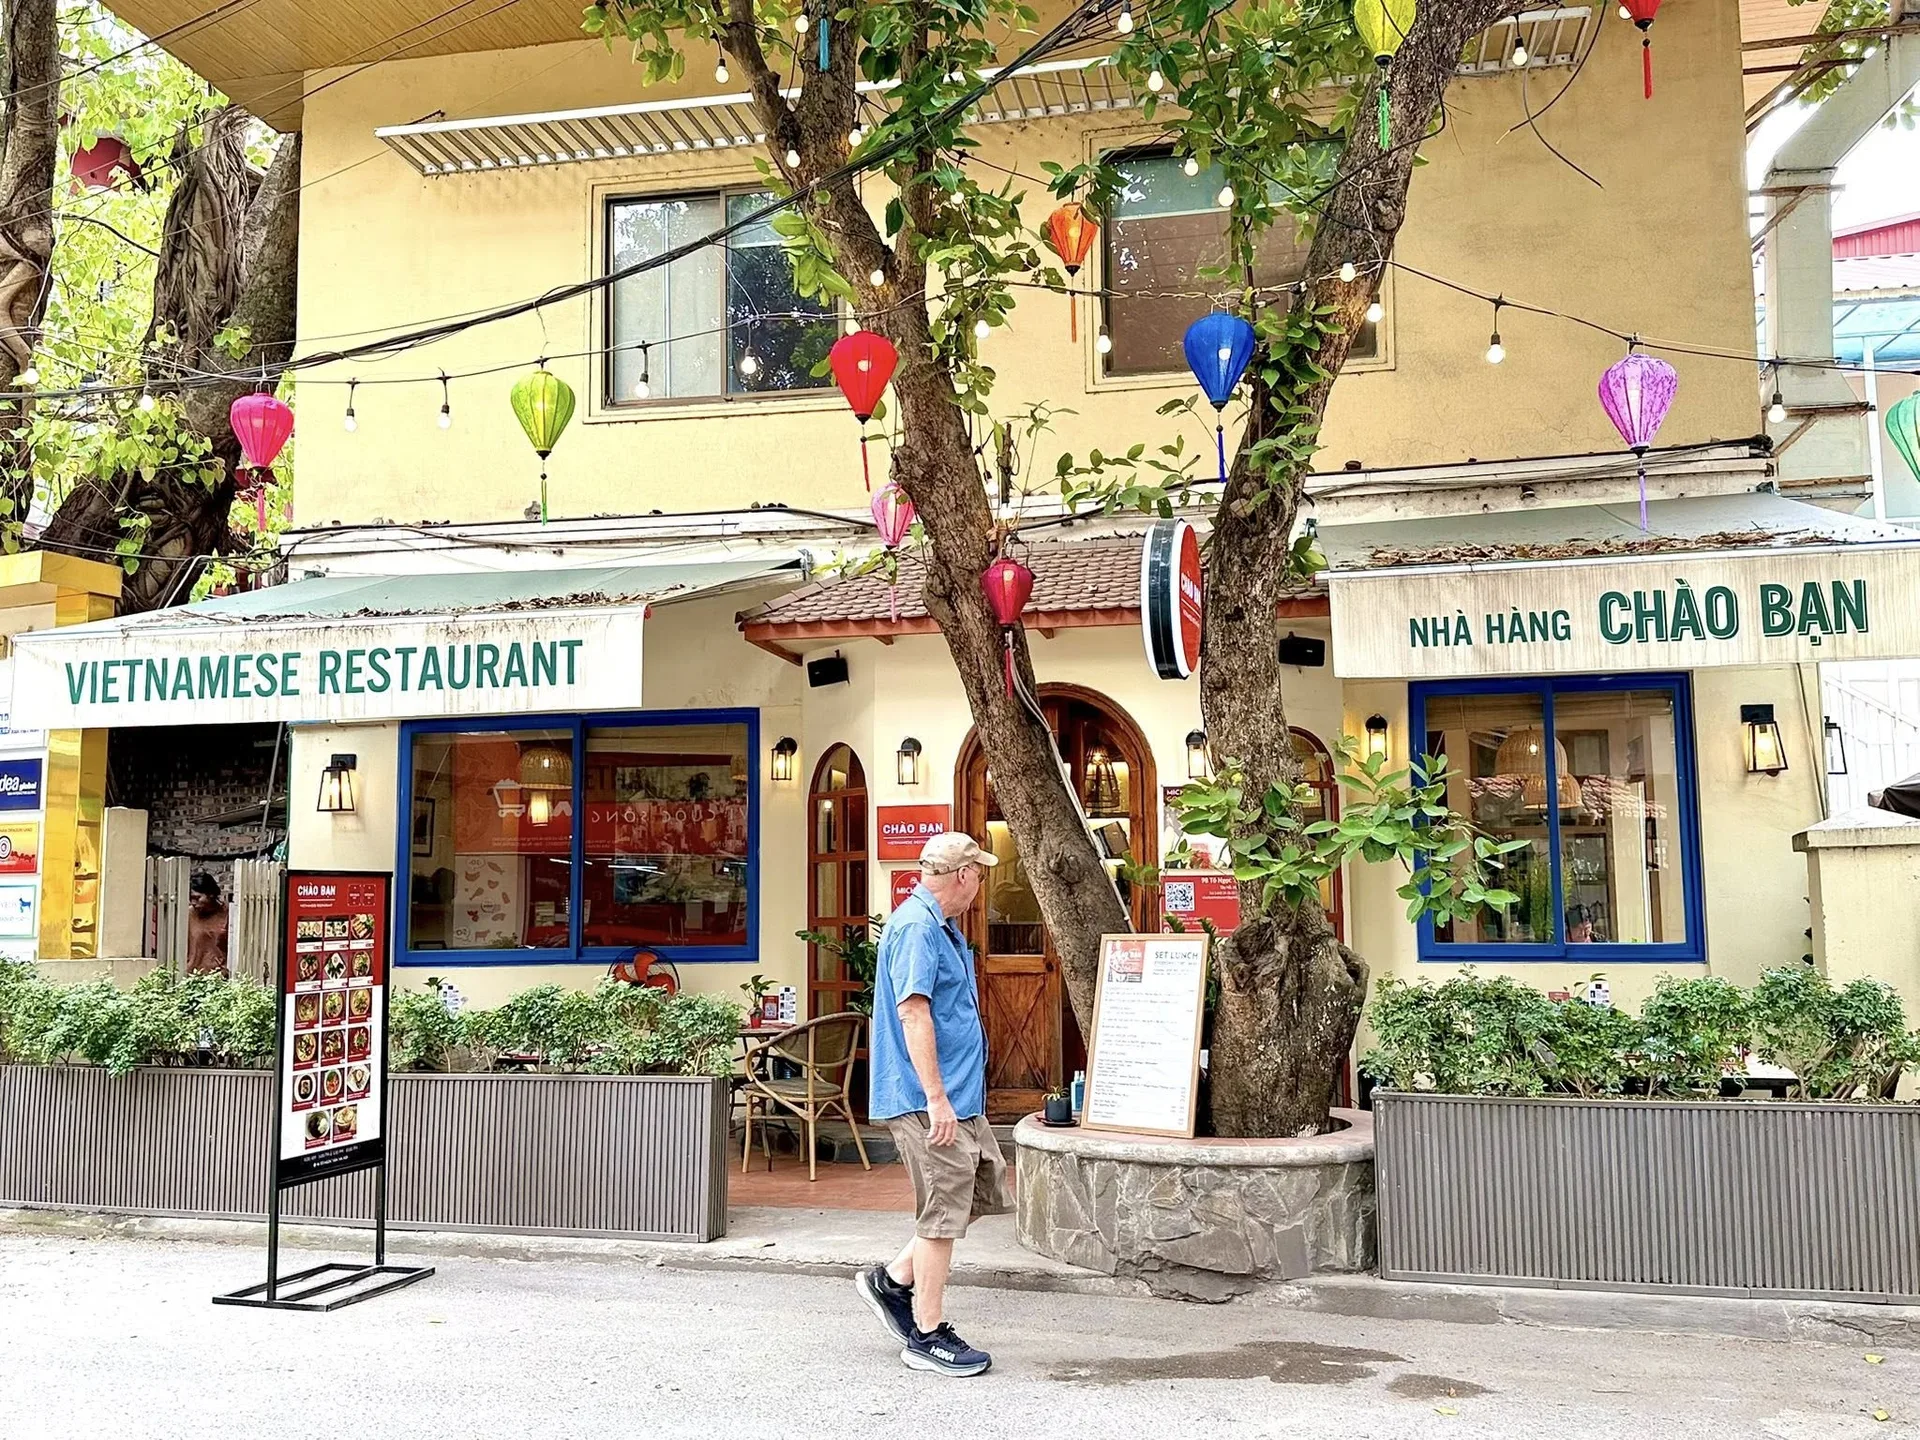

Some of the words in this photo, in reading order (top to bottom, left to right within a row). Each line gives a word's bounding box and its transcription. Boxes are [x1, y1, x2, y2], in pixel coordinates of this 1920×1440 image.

[1409, 609, 1473, 647] NHÀ
[1486, 606, 1572, 642] HÀNG
[1598, 577, 1739, 644] CHÀO
[1759, 579, 1869, 646] BẠN
[65, 652, 301, 704] VIETNAMESE
[318, 639, 583, 694] RESTAURANT
[882, 820, 915, 834] CHÀO
[919, 822, 944, 835] BẠN
[297, 882, 319, 896] CHÀO
[320, 886, 336, 898] BẠN
[1155, 951, 1169, 959] SET
[1170, 951, 1199, 960] LUNCH
[930, 1346, 955, 1362] HOKA
